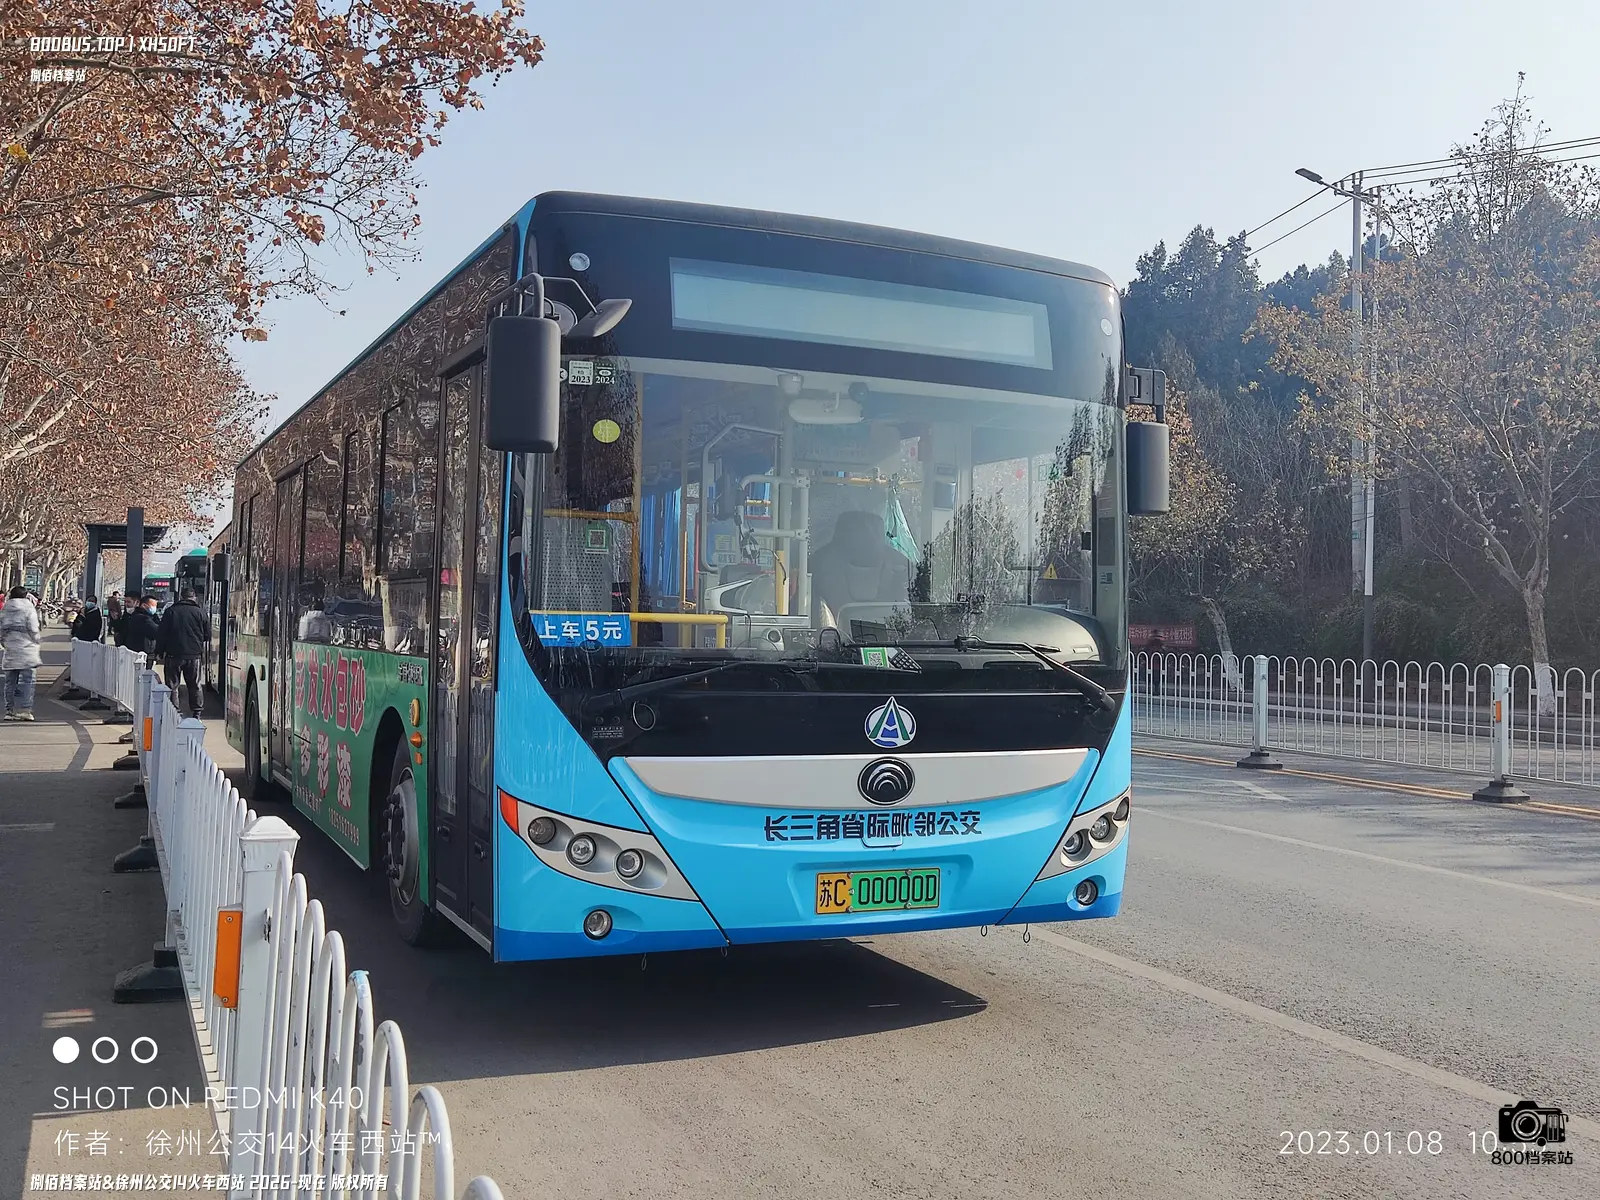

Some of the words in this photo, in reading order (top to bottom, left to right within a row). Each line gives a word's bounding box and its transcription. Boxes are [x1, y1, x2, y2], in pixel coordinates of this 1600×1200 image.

[571, 375, 591, 383] 2023
[595, 375, 616, 384] 2024
[539, 620, 622, 641] 上车5元
[764, 810, 982, 841] 长三角省际毗邻公交
